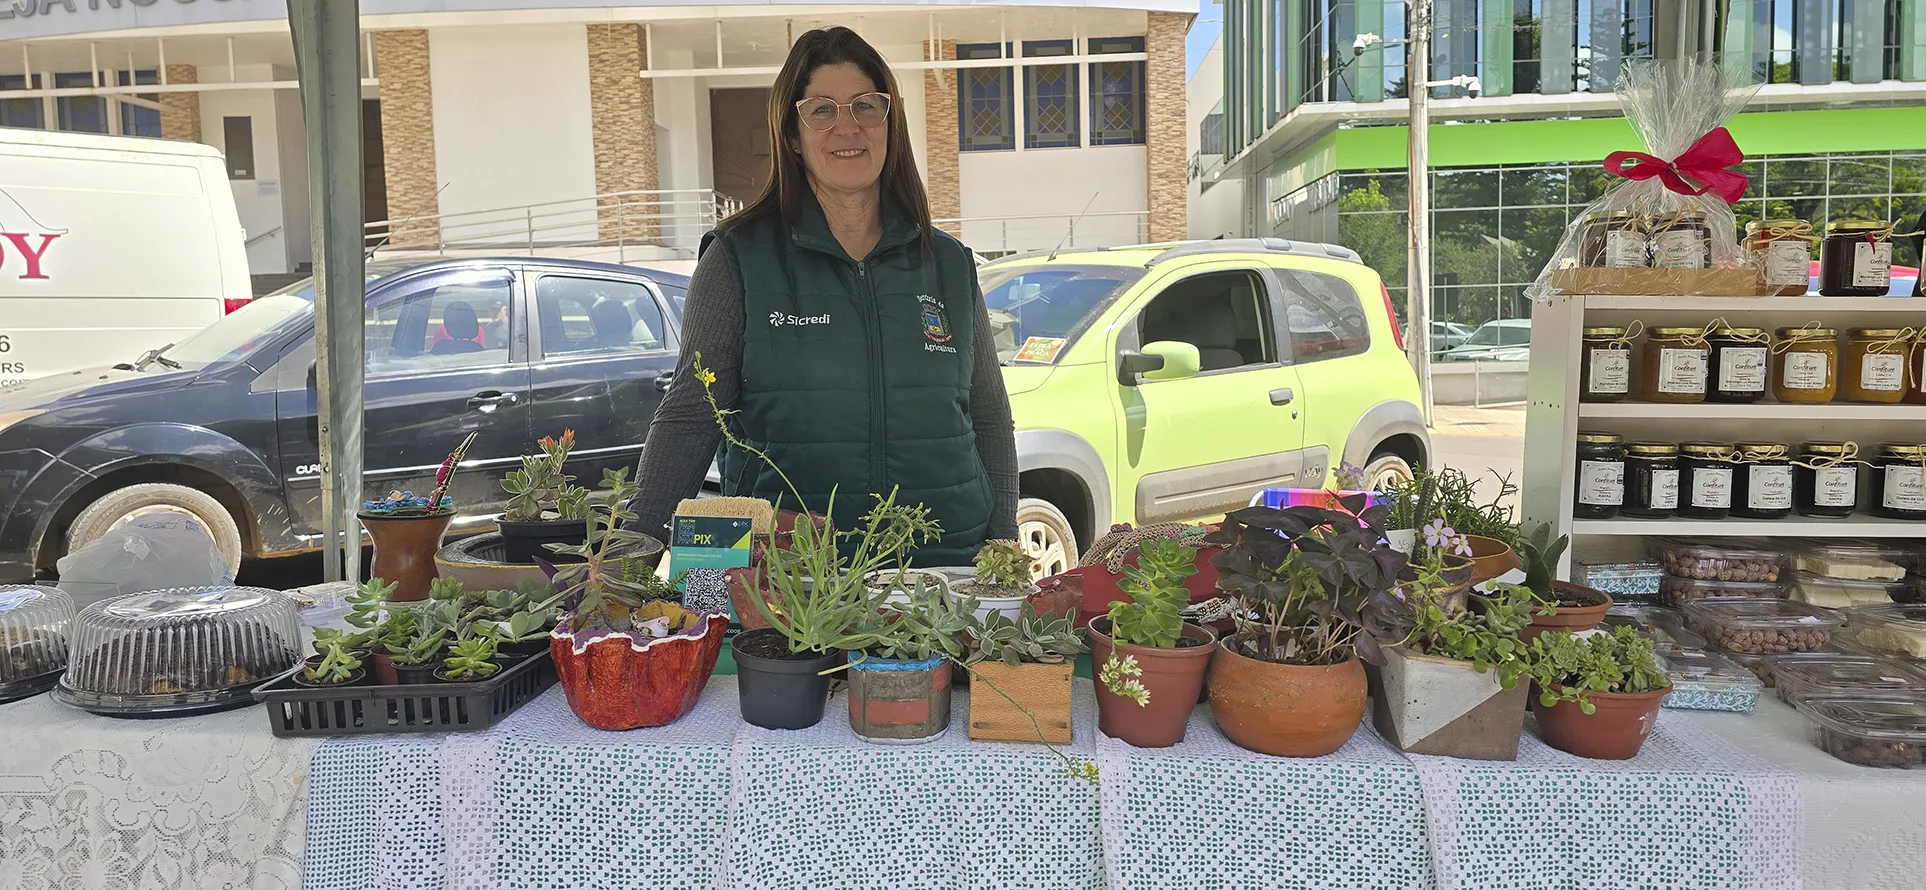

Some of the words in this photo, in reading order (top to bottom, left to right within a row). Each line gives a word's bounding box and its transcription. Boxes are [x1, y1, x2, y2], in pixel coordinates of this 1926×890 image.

[0, 232, 62, 279] Y
[786, 313, 831, 326] Sicredi
[693, 533, 712, 545] PIX
